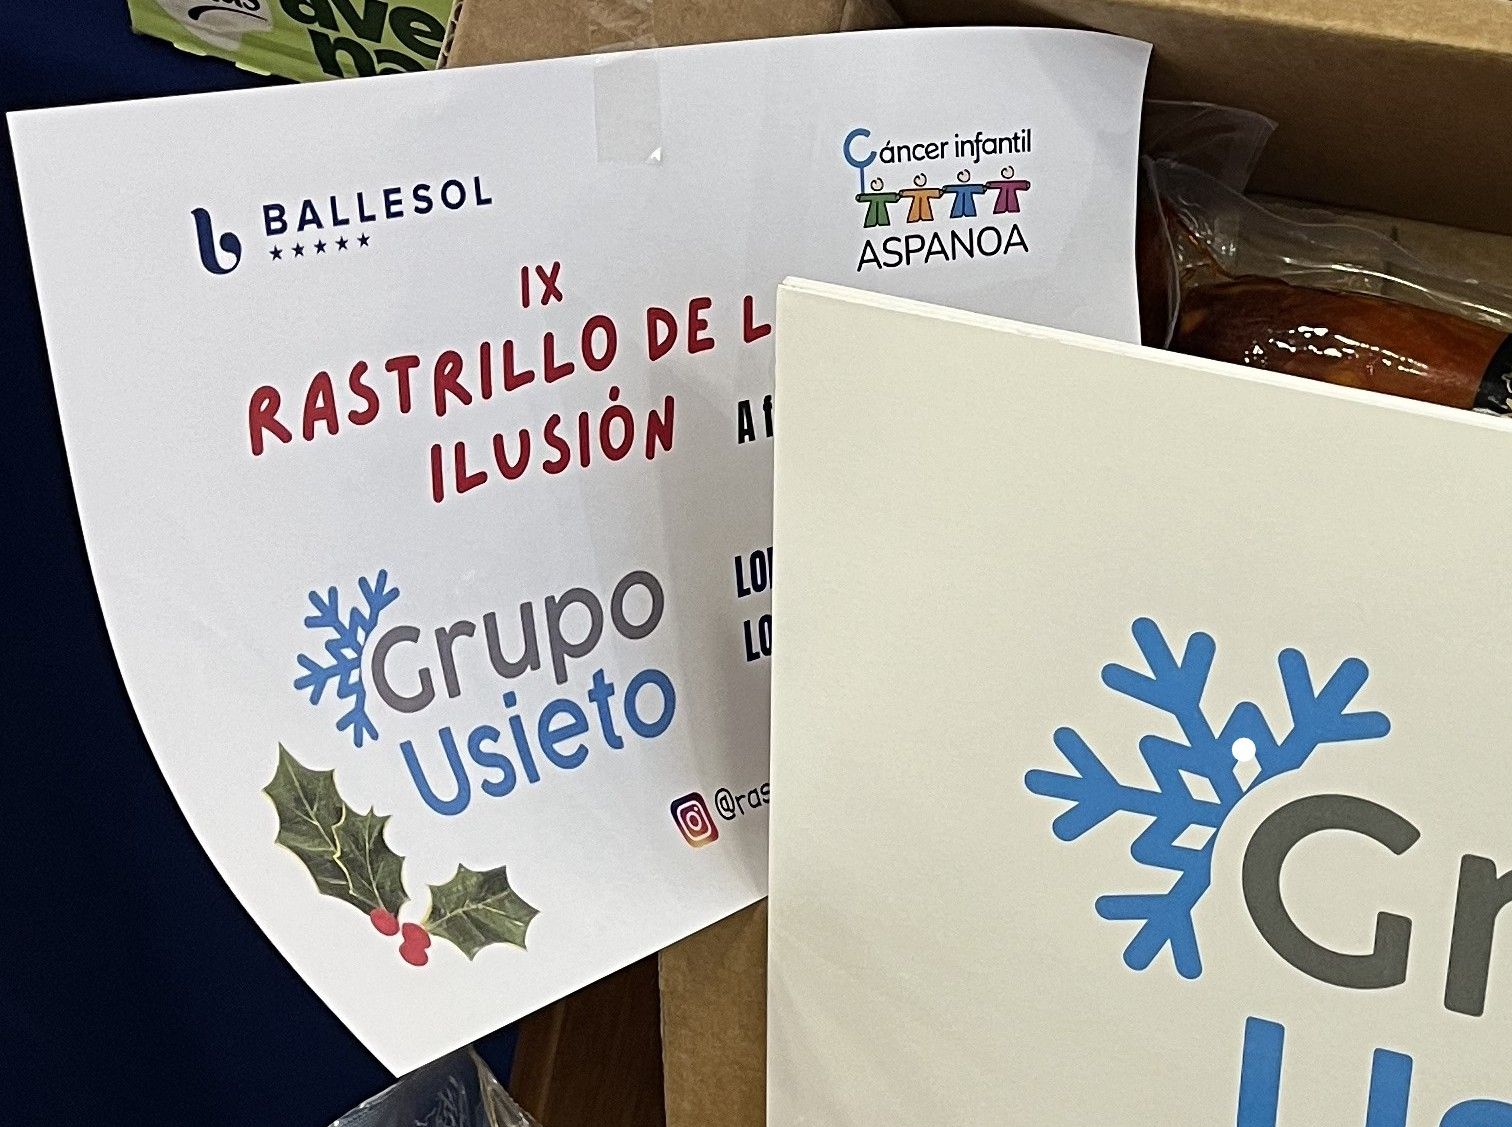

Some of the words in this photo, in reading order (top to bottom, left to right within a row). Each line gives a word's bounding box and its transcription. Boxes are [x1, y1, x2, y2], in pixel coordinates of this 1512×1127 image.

[954, 128, 1032, 164] infantil
[263, 175, 493, 237] BALLESOL
[856, 223, 1029, 272] ASPANOA
[520, 260, 564, 309] IX
[248, 314, 618, 457] RASTRILLO
[646, 297, 715, 362] DE
[431, 386, 675, 503] ILUSIÓN
[738, 399, 756, 444] A
[370, 570, 665, 714] Grupo
[399, 667, 676, 816] Usieto
